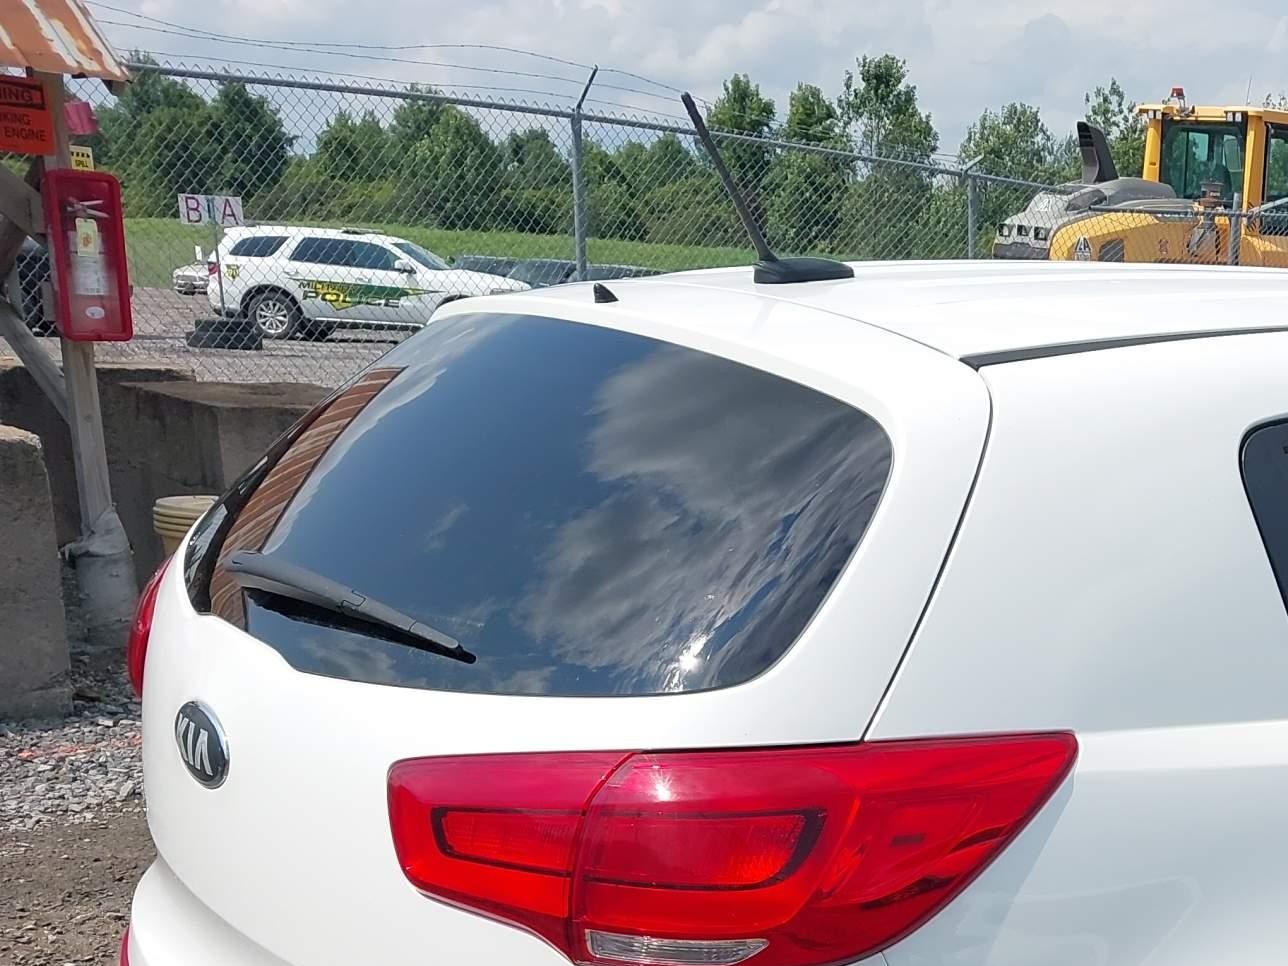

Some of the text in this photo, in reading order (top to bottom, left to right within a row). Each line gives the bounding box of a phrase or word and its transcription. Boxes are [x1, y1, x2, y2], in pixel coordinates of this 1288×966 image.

[0, 86, 33, 104] ING
[4, 126, 47, 142] ENGINE
[302, 290, 400, 308] POLICE
[176, 712, 214, 777] KIA
